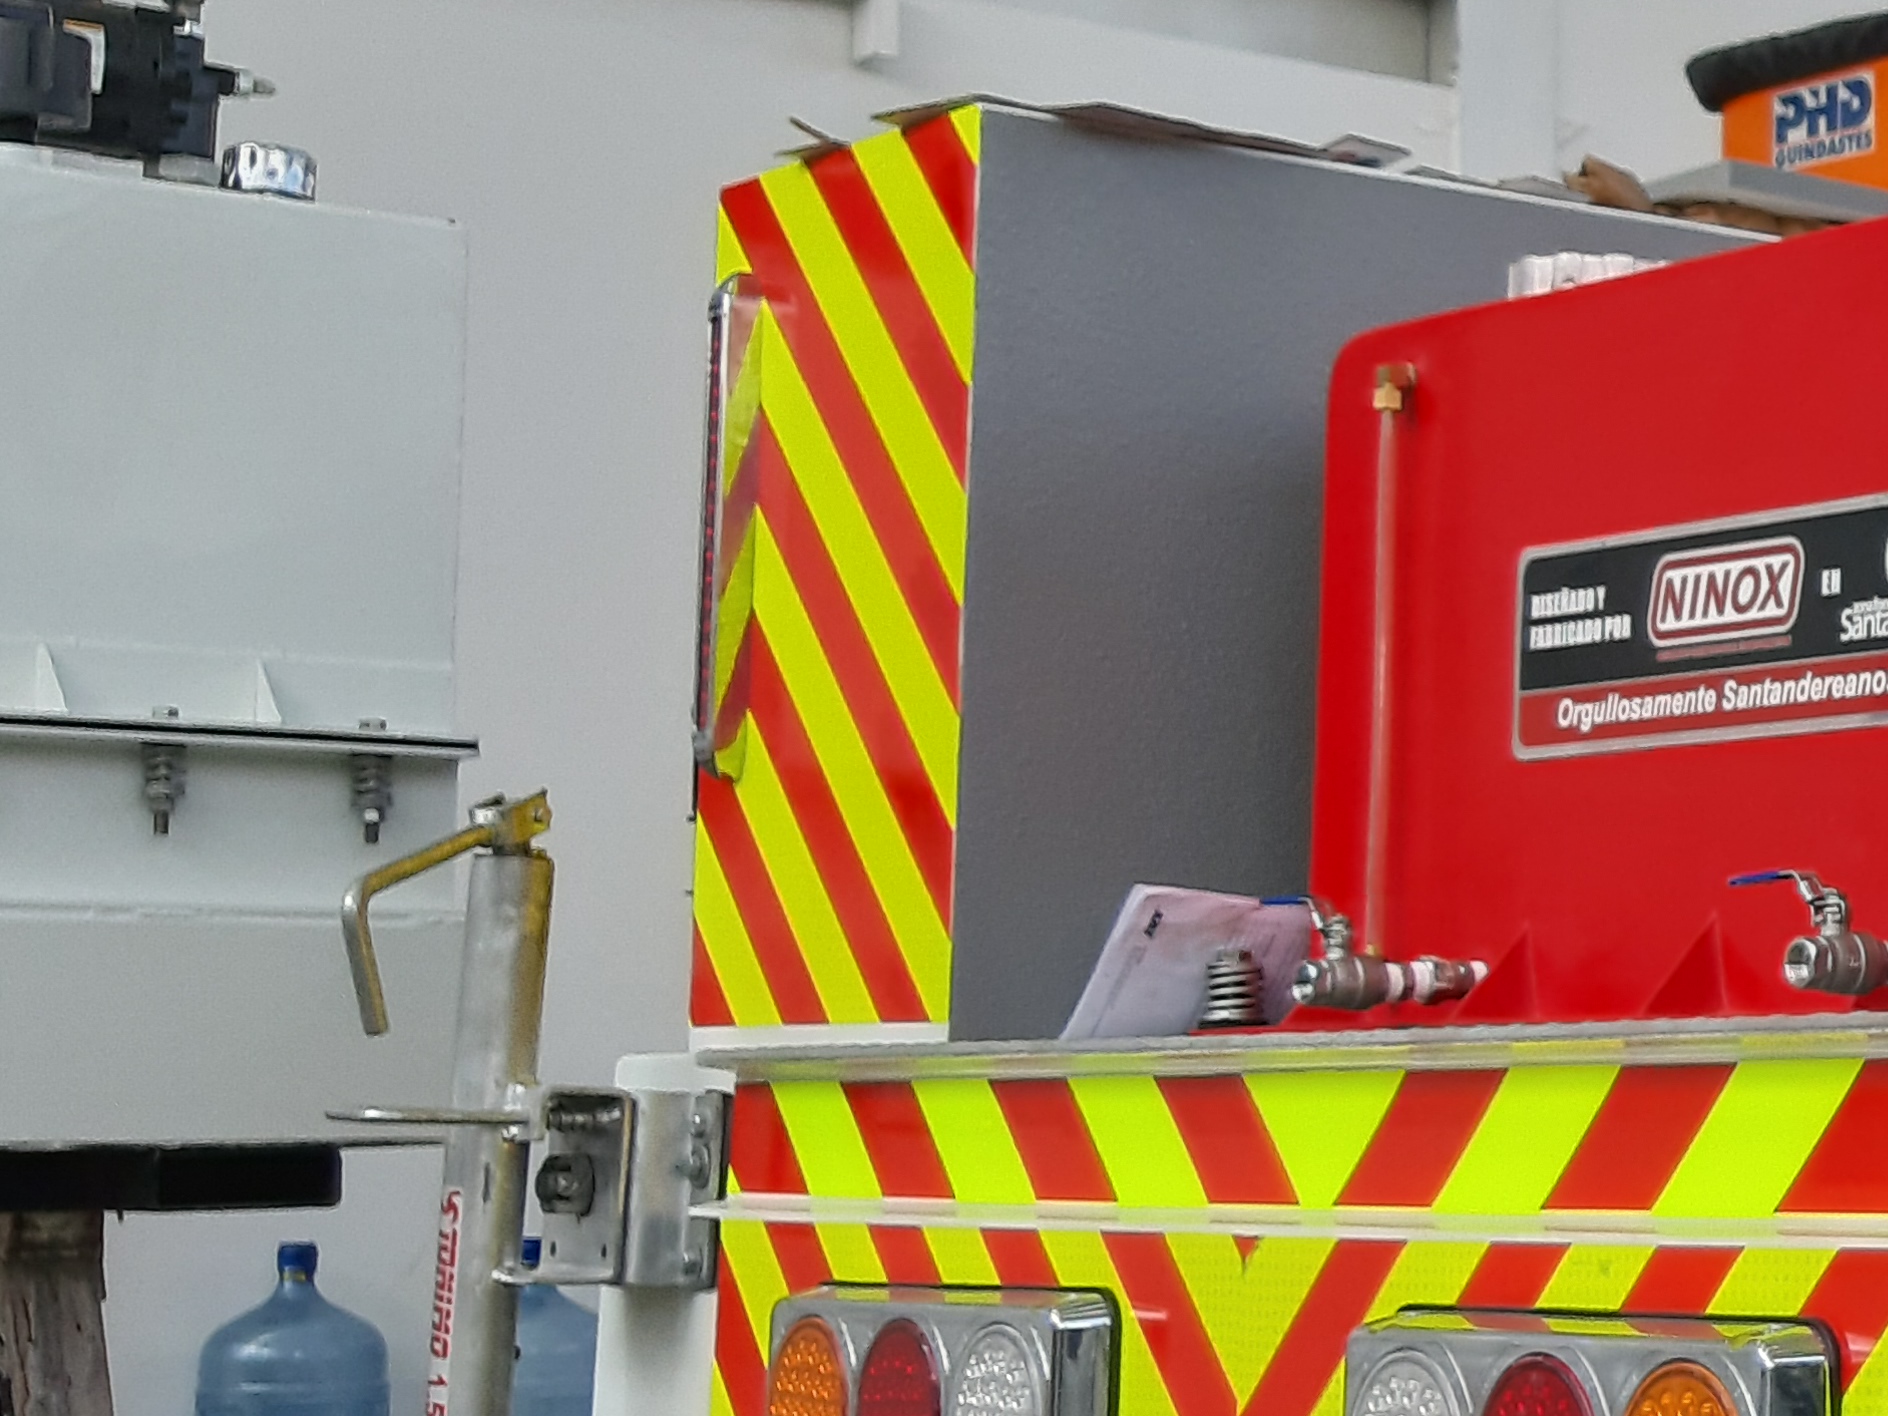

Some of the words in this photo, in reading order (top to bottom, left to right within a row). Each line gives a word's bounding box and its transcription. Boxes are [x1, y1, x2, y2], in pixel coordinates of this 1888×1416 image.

[1775, 76, 1872, 144] PHD
[1775, 130, 1872, 168] GUINDASTES
[1660, 558, 1791, 625] NINOX
[1556, 682, 1718, 733] Orgullosamente
